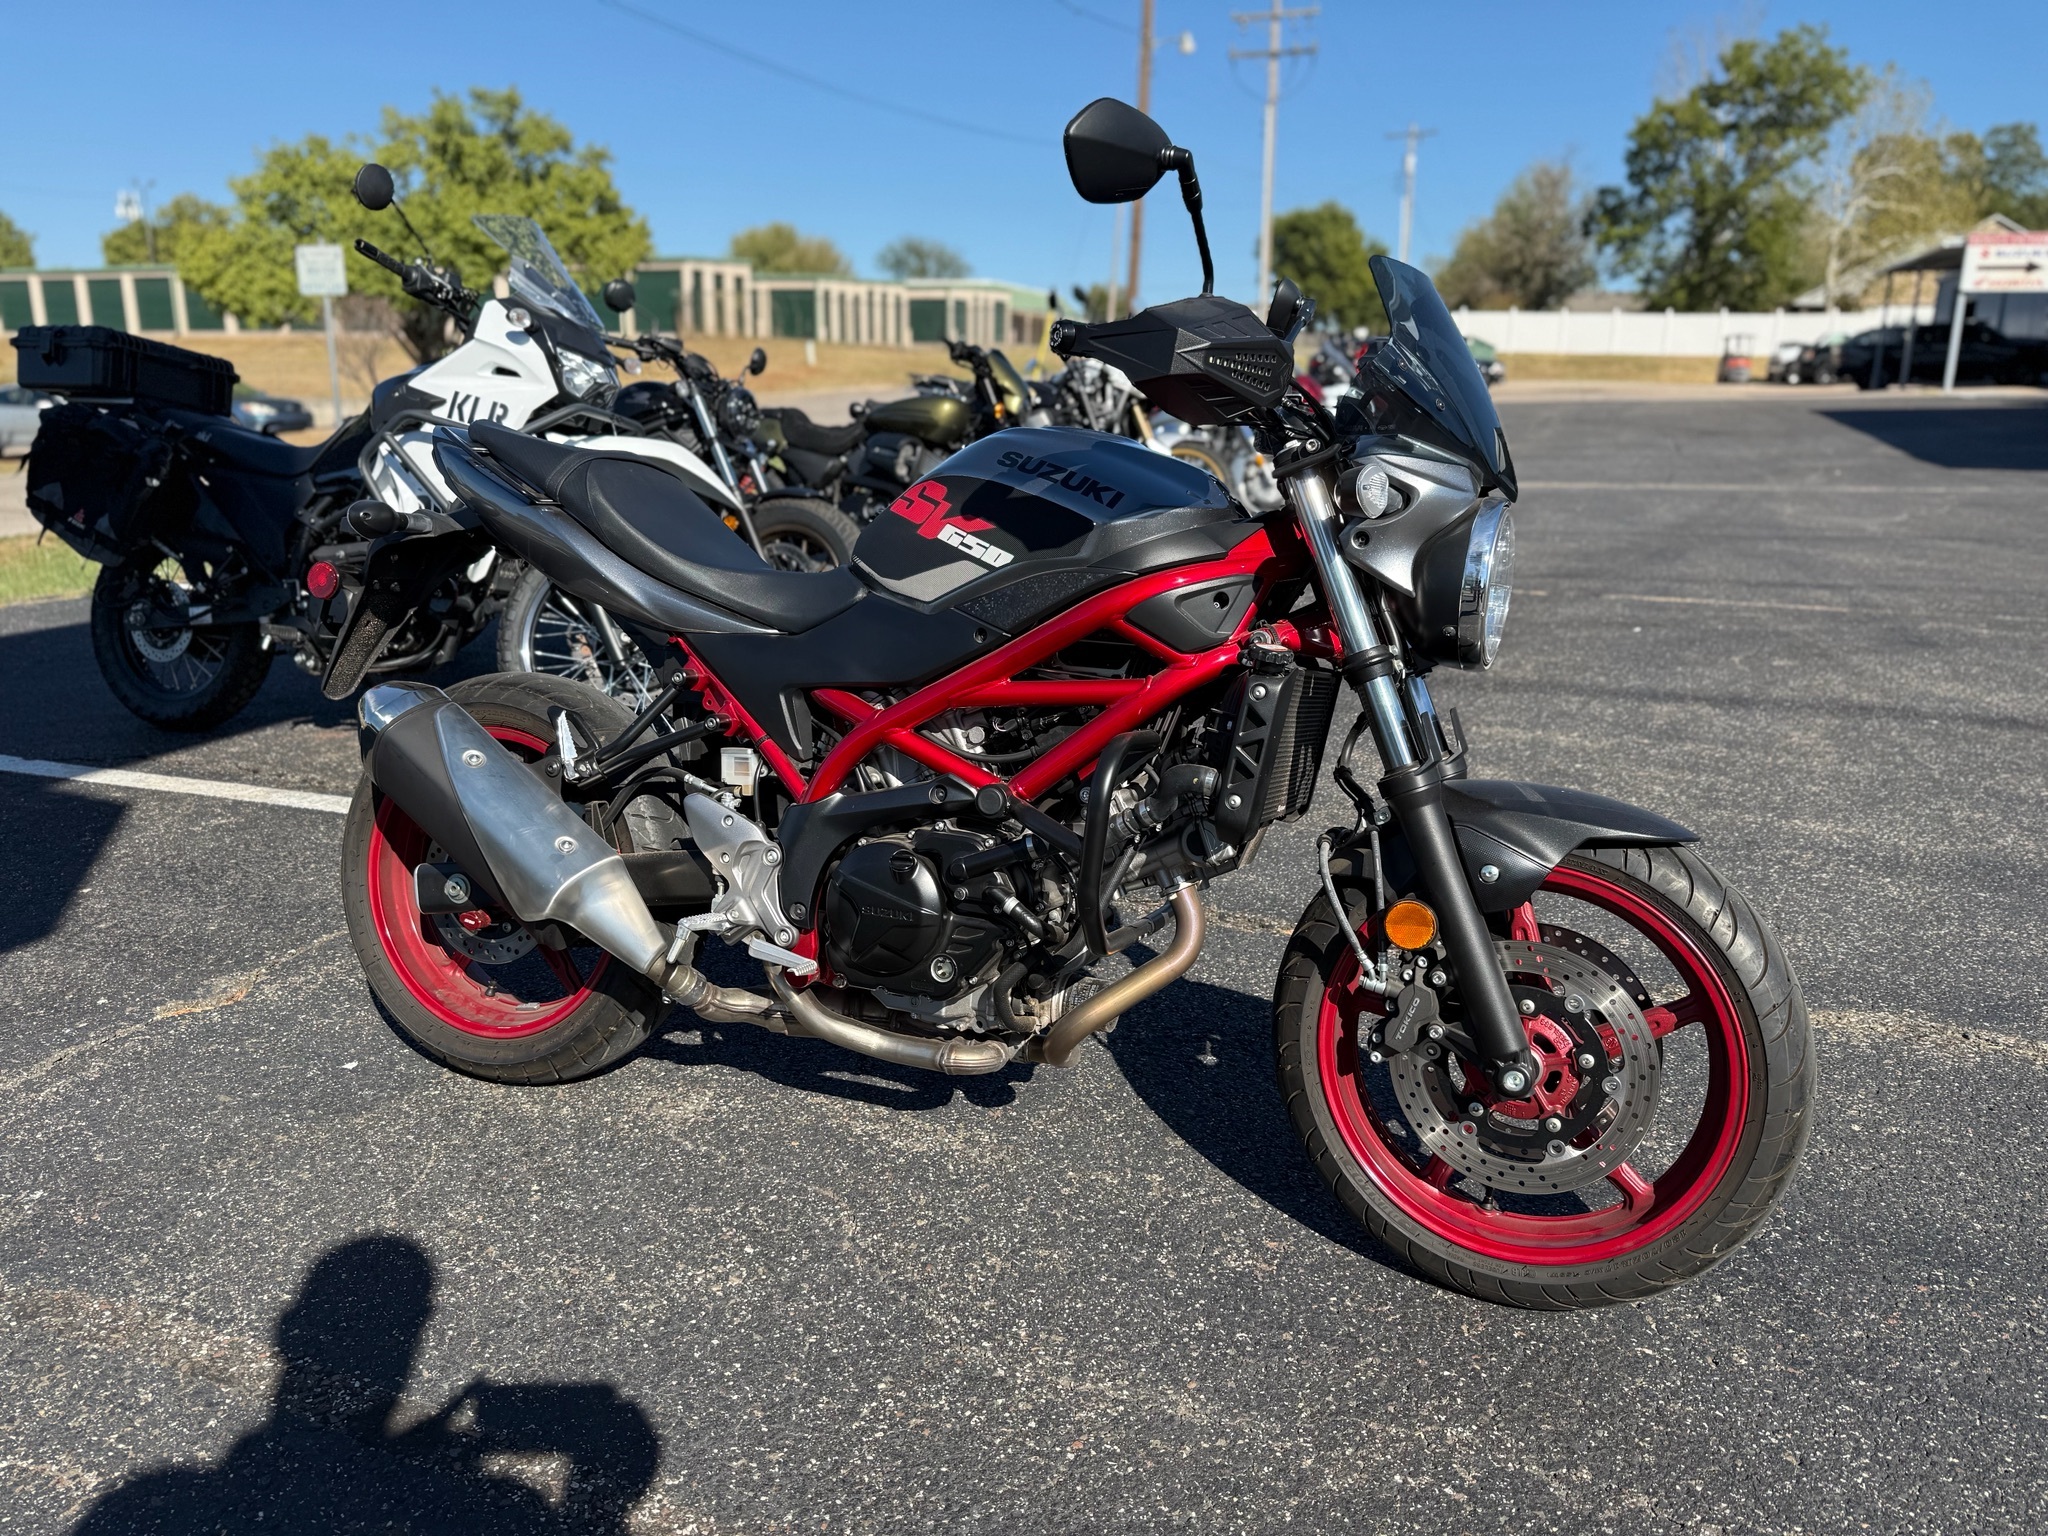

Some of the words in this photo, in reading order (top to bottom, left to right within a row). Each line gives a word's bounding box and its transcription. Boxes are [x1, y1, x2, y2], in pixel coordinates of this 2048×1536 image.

[448, 391, 507, 425] KLR
[996, 450, 1125, 510] SUZUKI
[890, 480, 997, 540] SV
[937, 523, 1014, 568] 650
[862, 906, 913, 921] SUZUKI
[1395, 997, 1421, 1040] TOKICO
[1346, 1164, 1402, 1222] DUNLOP
